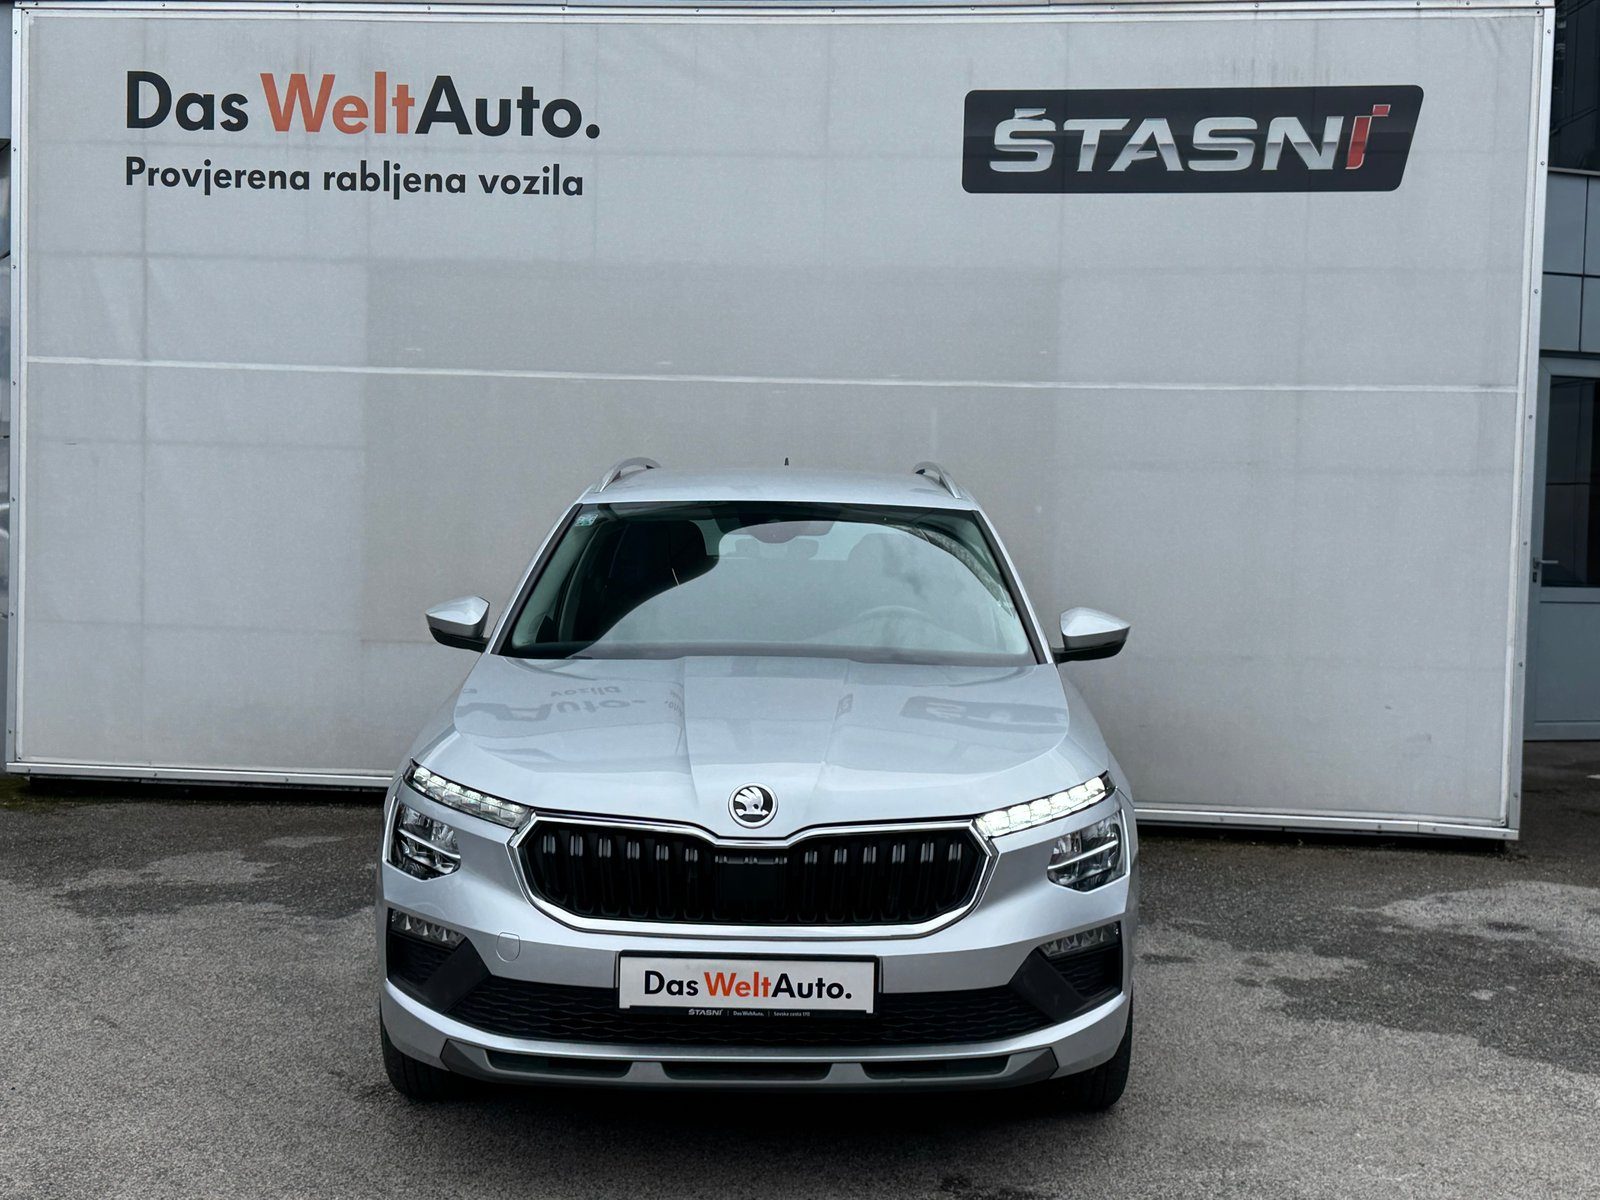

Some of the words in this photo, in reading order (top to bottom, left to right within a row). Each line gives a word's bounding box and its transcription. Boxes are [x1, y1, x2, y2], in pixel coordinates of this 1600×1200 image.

[127, 70, 249, 133] Das
[260, 71, 601, 140] WeltAuto.
[126, 155, 310, 197] Provjerena
[323, 159, 466, 201] rabljena
[478, 163, 583, 197] vozila
[644, 970, 699, 997] Das
[704, 971, 853, 1000] WeltAuto.
